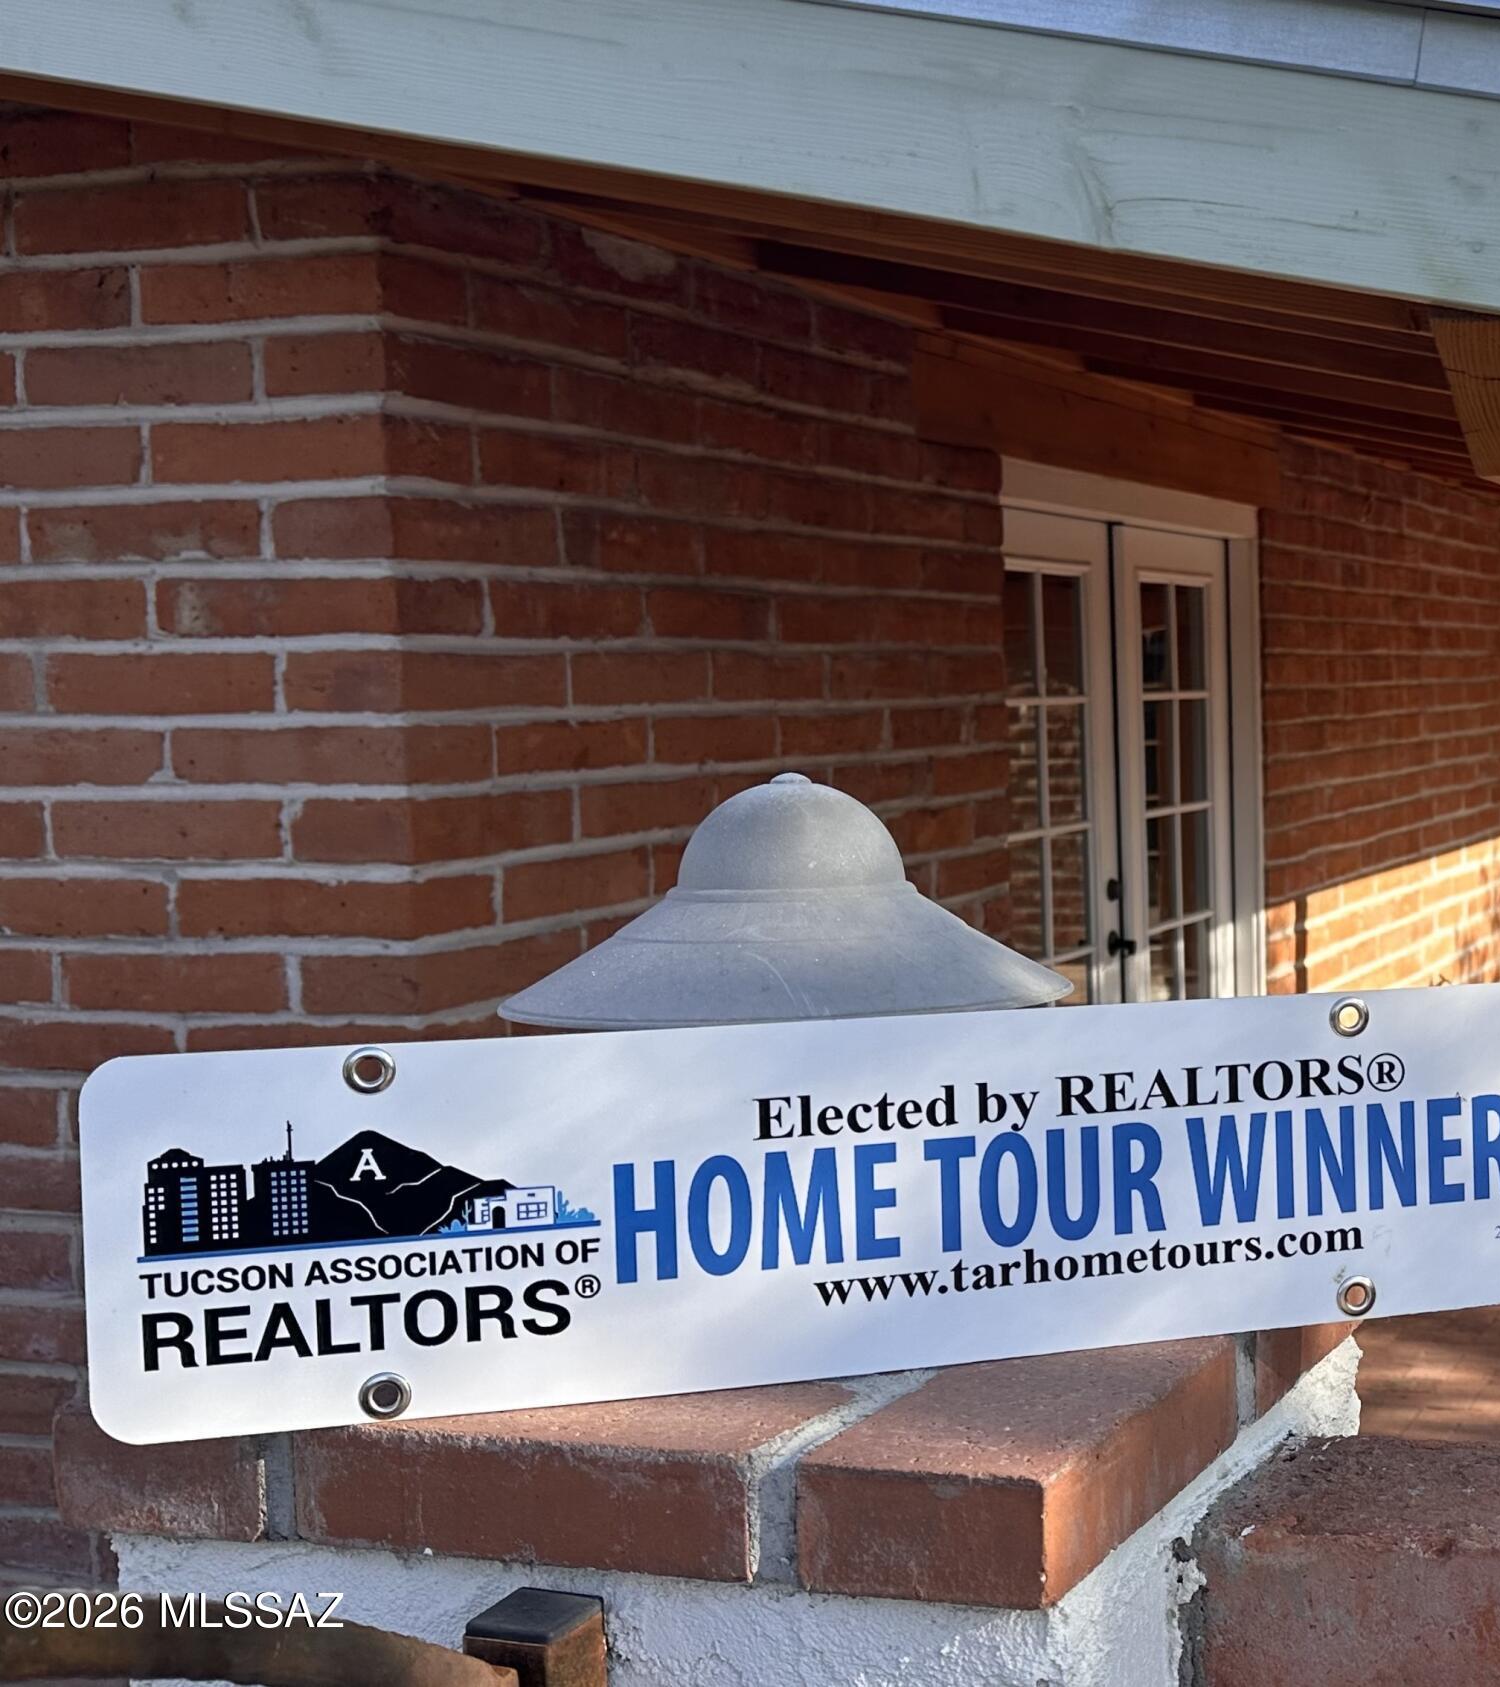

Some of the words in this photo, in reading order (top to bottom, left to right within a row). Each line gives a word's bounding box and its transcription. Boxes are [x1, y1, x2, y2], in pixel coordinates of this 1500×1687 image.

[753, 1084, 956, 1140] Elected
[977, 1081, 1039, 1132] by
[613, 1142, 901, 1285] HOME
[924, 1121, 1167, 1252] TOUR
[139, 1263, 293, 1299] TUCSON
[304, 1242, 545, 1286] ASSOCIATION
[555, 1238, 600, 1265] OF
[814, 1226, 1364, 1306] www.tarhometours.com
